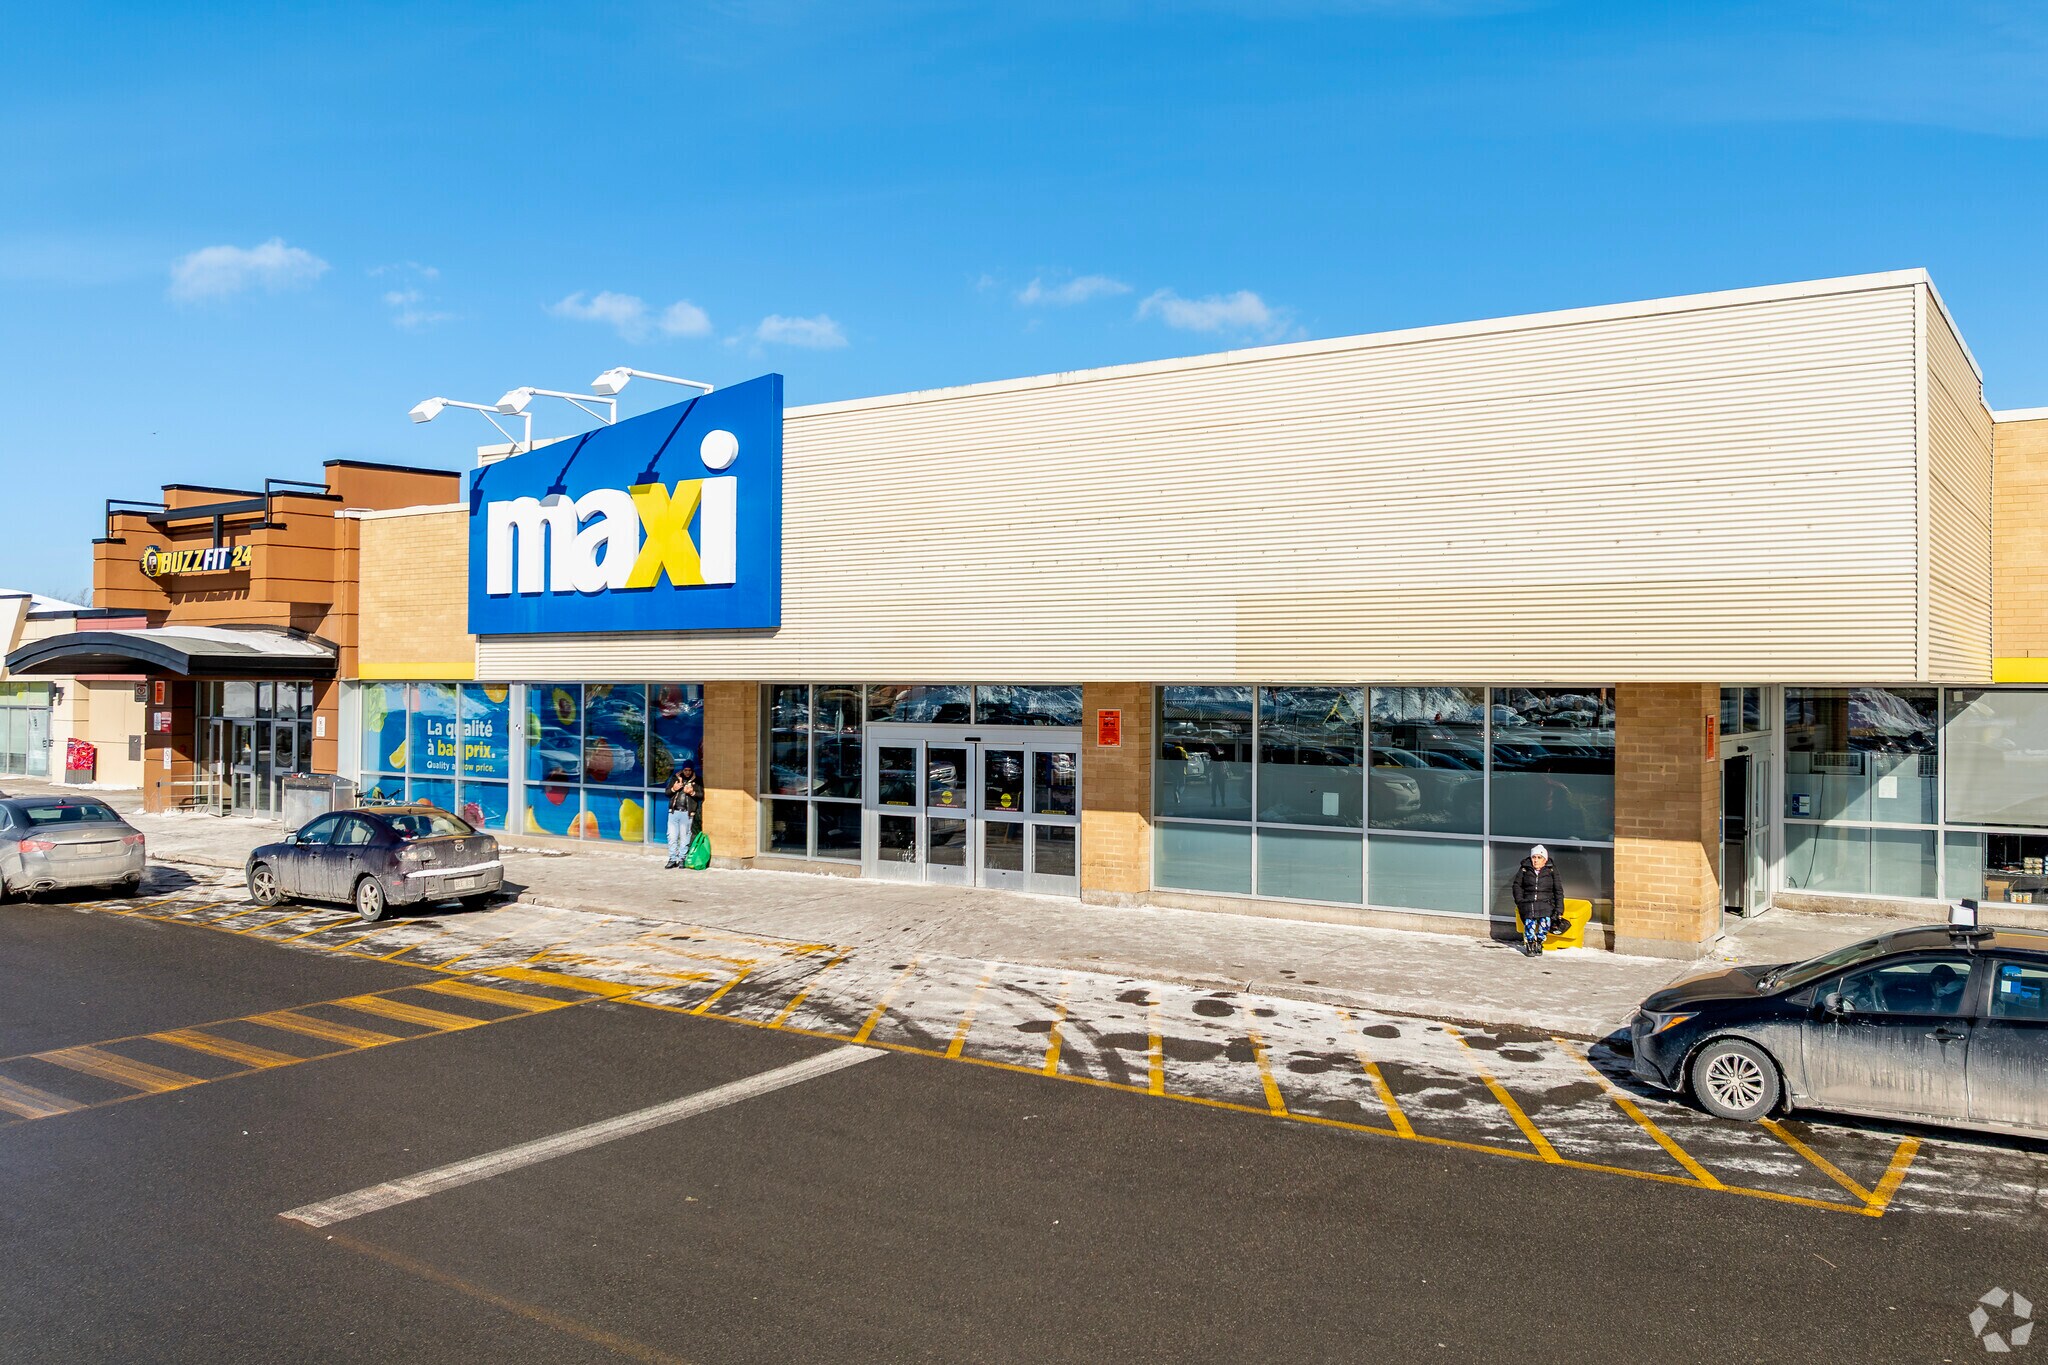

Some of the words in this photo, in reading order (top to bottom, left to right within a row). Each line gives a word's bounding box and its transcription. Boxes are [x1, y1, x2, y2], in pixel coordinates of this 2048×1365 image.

[486, 429, 739, 595] maxi
[160, 548, 230, 573] BUZZFIT
[231, 545, 252, 567] 24
[427, 719, 443, 736] La
[445, 719, 493, 739] qalité
[427, 738, 435, 756] à
[465, 741, 496, 760] prix.
[426, 760, 450, 771] Quality
[475, 763, 496, 772] price.
